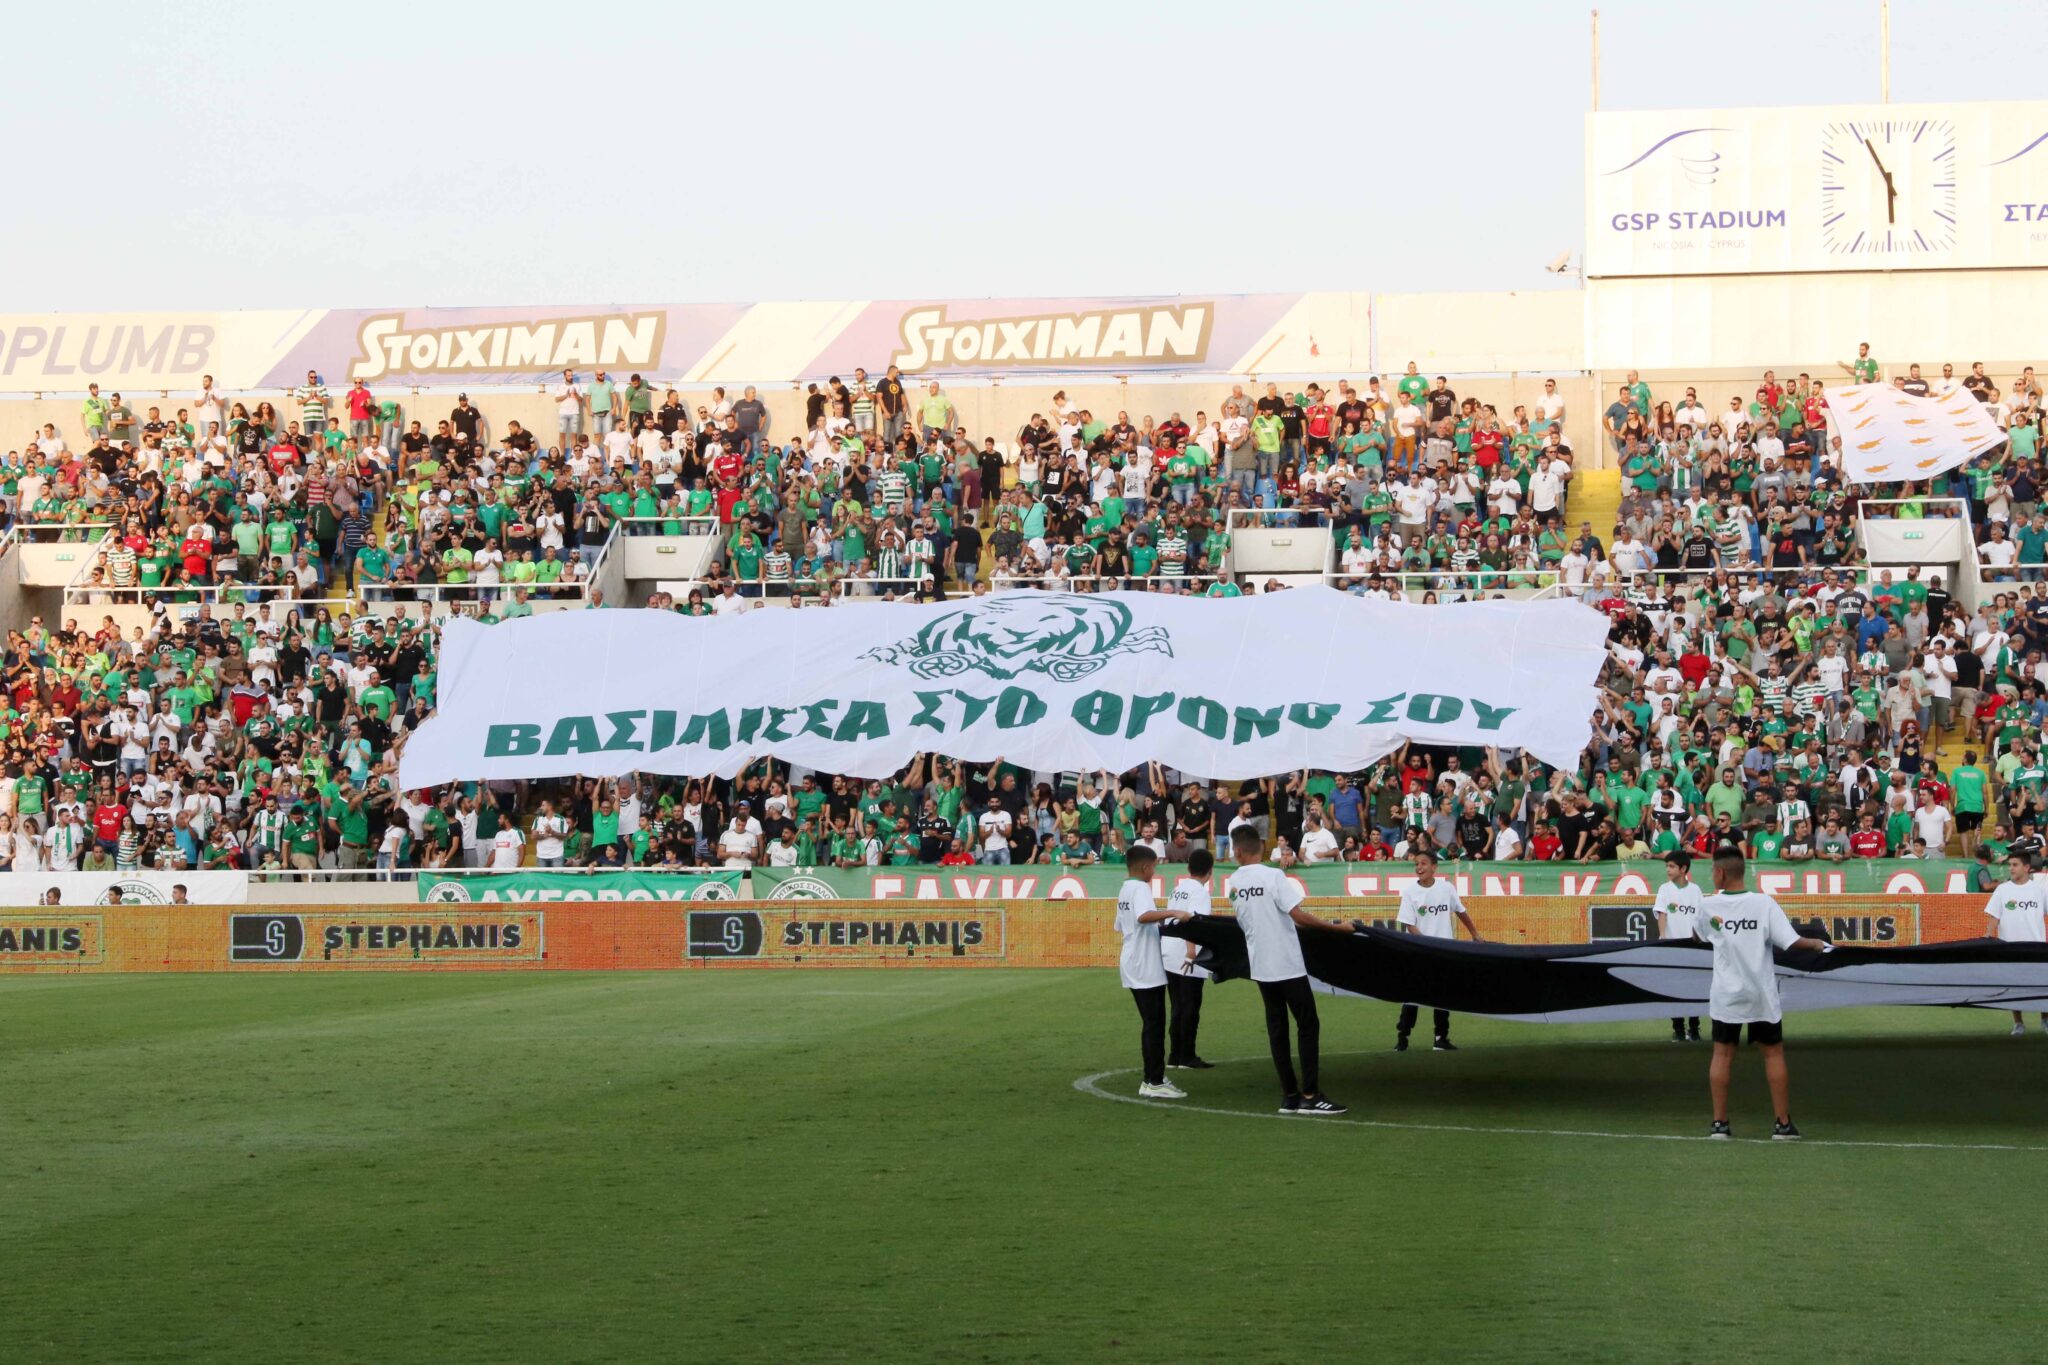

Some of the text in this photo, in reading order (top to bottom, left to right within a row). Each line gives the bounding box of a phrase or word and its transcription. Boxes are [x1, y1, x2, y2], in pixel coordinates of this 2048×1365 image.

[1612, 210, 1786, 231] GSP STADIUM
[0, 324, 215, 375] PLUMB
[351, 316, 659, 378] STOIXIMAN
[895, 307, 1206, 371] STOIXIMAN
[1071, 691, 1342, 745] ΘΡΟΝΟ
[1357, 692, 1522, 730] ΣΟΥ
[1238, 886, 1264, 901] cyta
[1428, 903, 1449, 916] cyta
[1679, 905, 1696, 915] cyta
[2018, 901, 2038, 910] cyta
[325, 924, 522, 950] STEPHANIS
[784, 922, 983, 946] STEPHANIS
[1725, 918, 1758, 935] cyta
